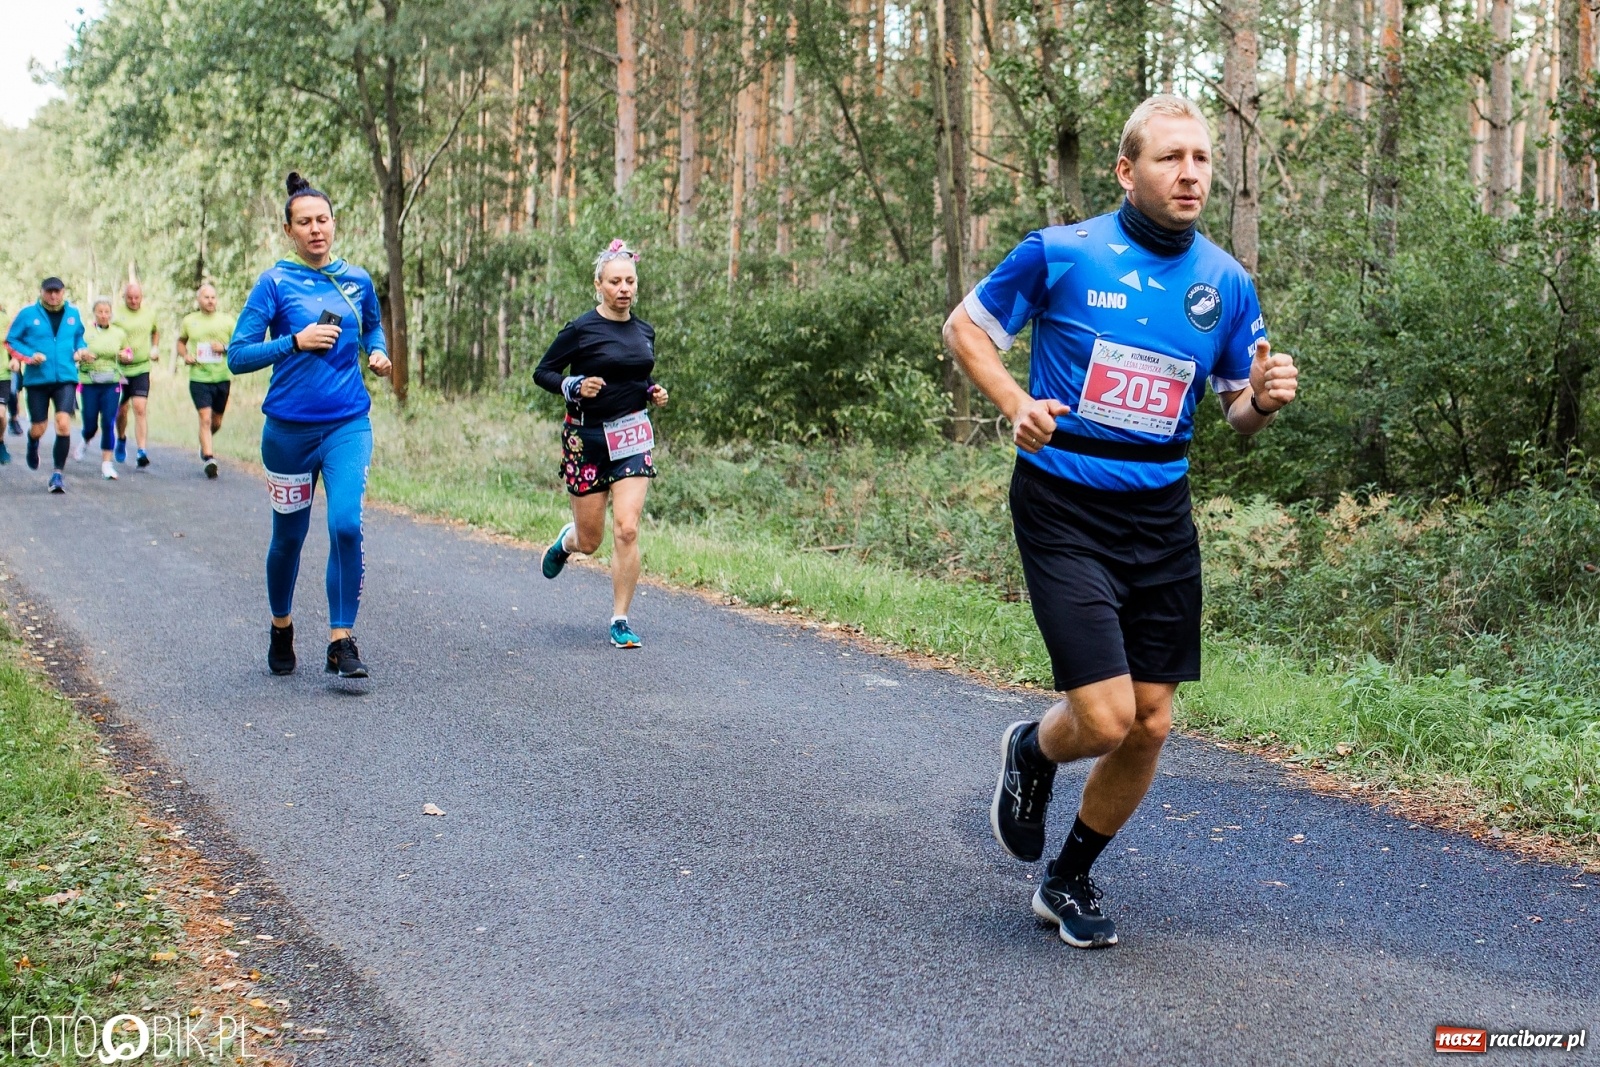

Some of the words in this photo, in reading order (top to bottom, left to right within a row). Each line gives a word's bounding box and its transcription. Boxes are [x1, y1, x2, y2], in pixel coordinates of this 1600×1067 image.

[1087, 289, 1127, 310] DANO
[1131, 352, 1160, 365] KUŹNIAŃSKA
[1100, 370, 1171, 413] 205
[615, 425, 647, 449] 234
[268, 482, 302, 504] 236
